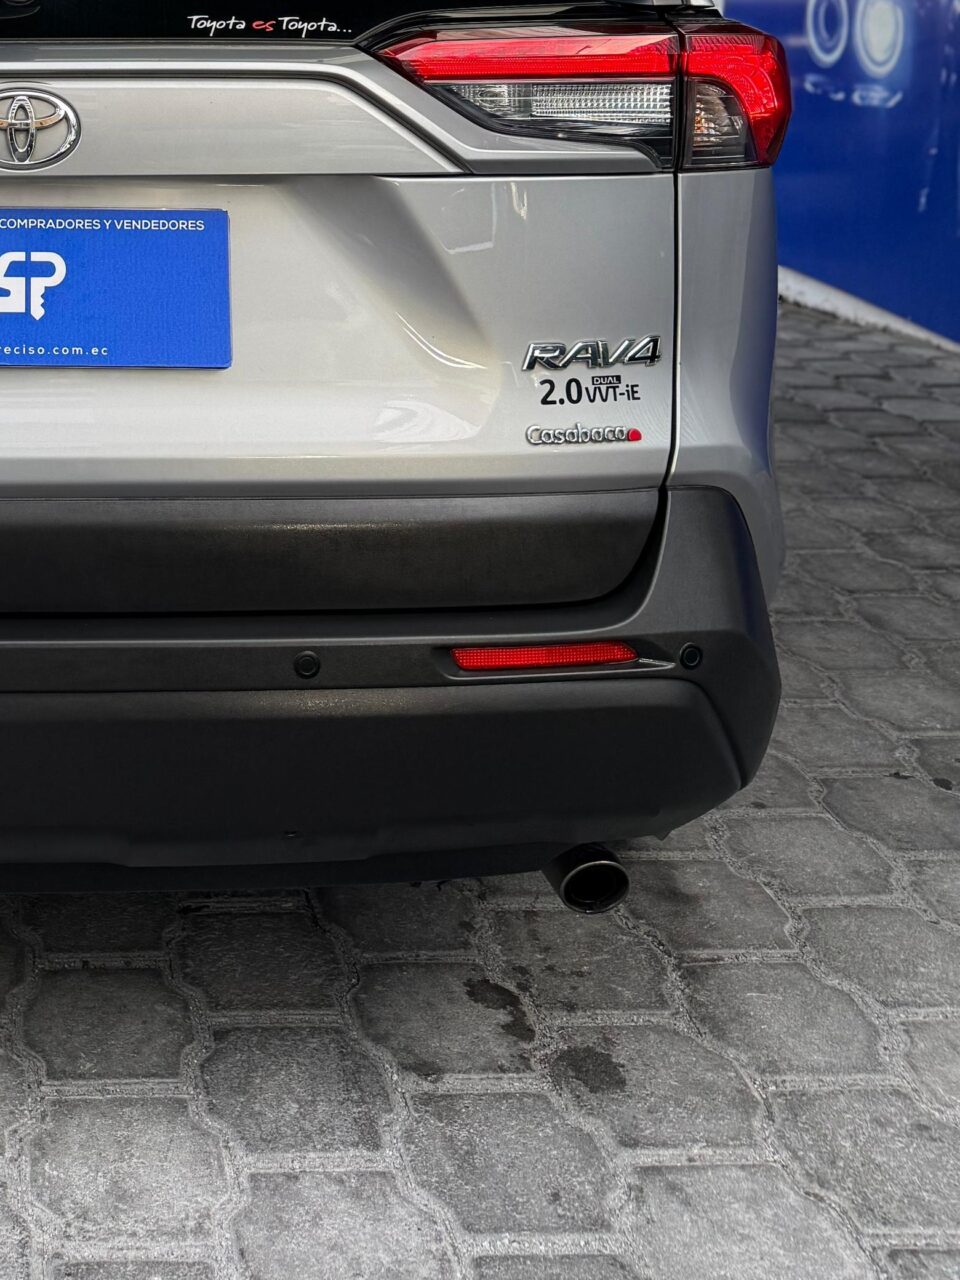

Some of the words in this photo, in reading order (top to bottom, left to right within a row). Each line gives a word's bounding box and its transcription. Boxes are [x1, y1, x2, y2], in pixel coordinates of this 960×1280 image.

[187, 15, 246, 37] Toyota
[252, 21, 277, 32] es
[104, 219, 113, 230] Y
[113, 219, 205, 232] VENDEDORES
[521, 334, 663, 371] RAV4
[539, 377, 583, 405] 2.0
[593, 375, 620, 386] DUAL
[525, 422, 628, 446] Casabaca
